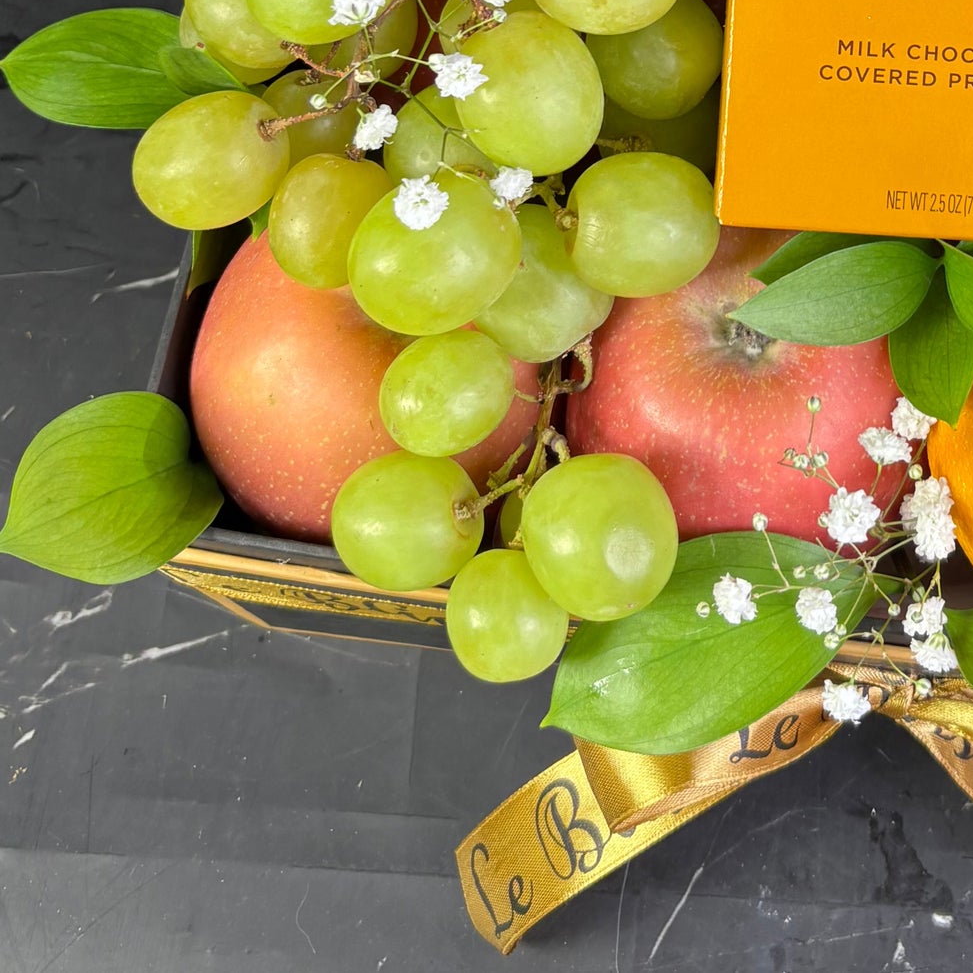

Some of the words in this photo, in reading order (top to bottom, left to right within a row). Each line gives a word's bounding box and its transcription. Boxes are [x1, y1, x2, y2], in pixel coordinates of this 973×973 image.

[838, 39, 896, 59] MILK
[819, 64, 937, 87] COVERED
[886, 190, 908, 210] NET
[910, 191, 928, 212] WT
[929, 193, 946, 213] 2.5
[947, 194, 963, 214] OZ
[471, 842, 534, 939] Le
